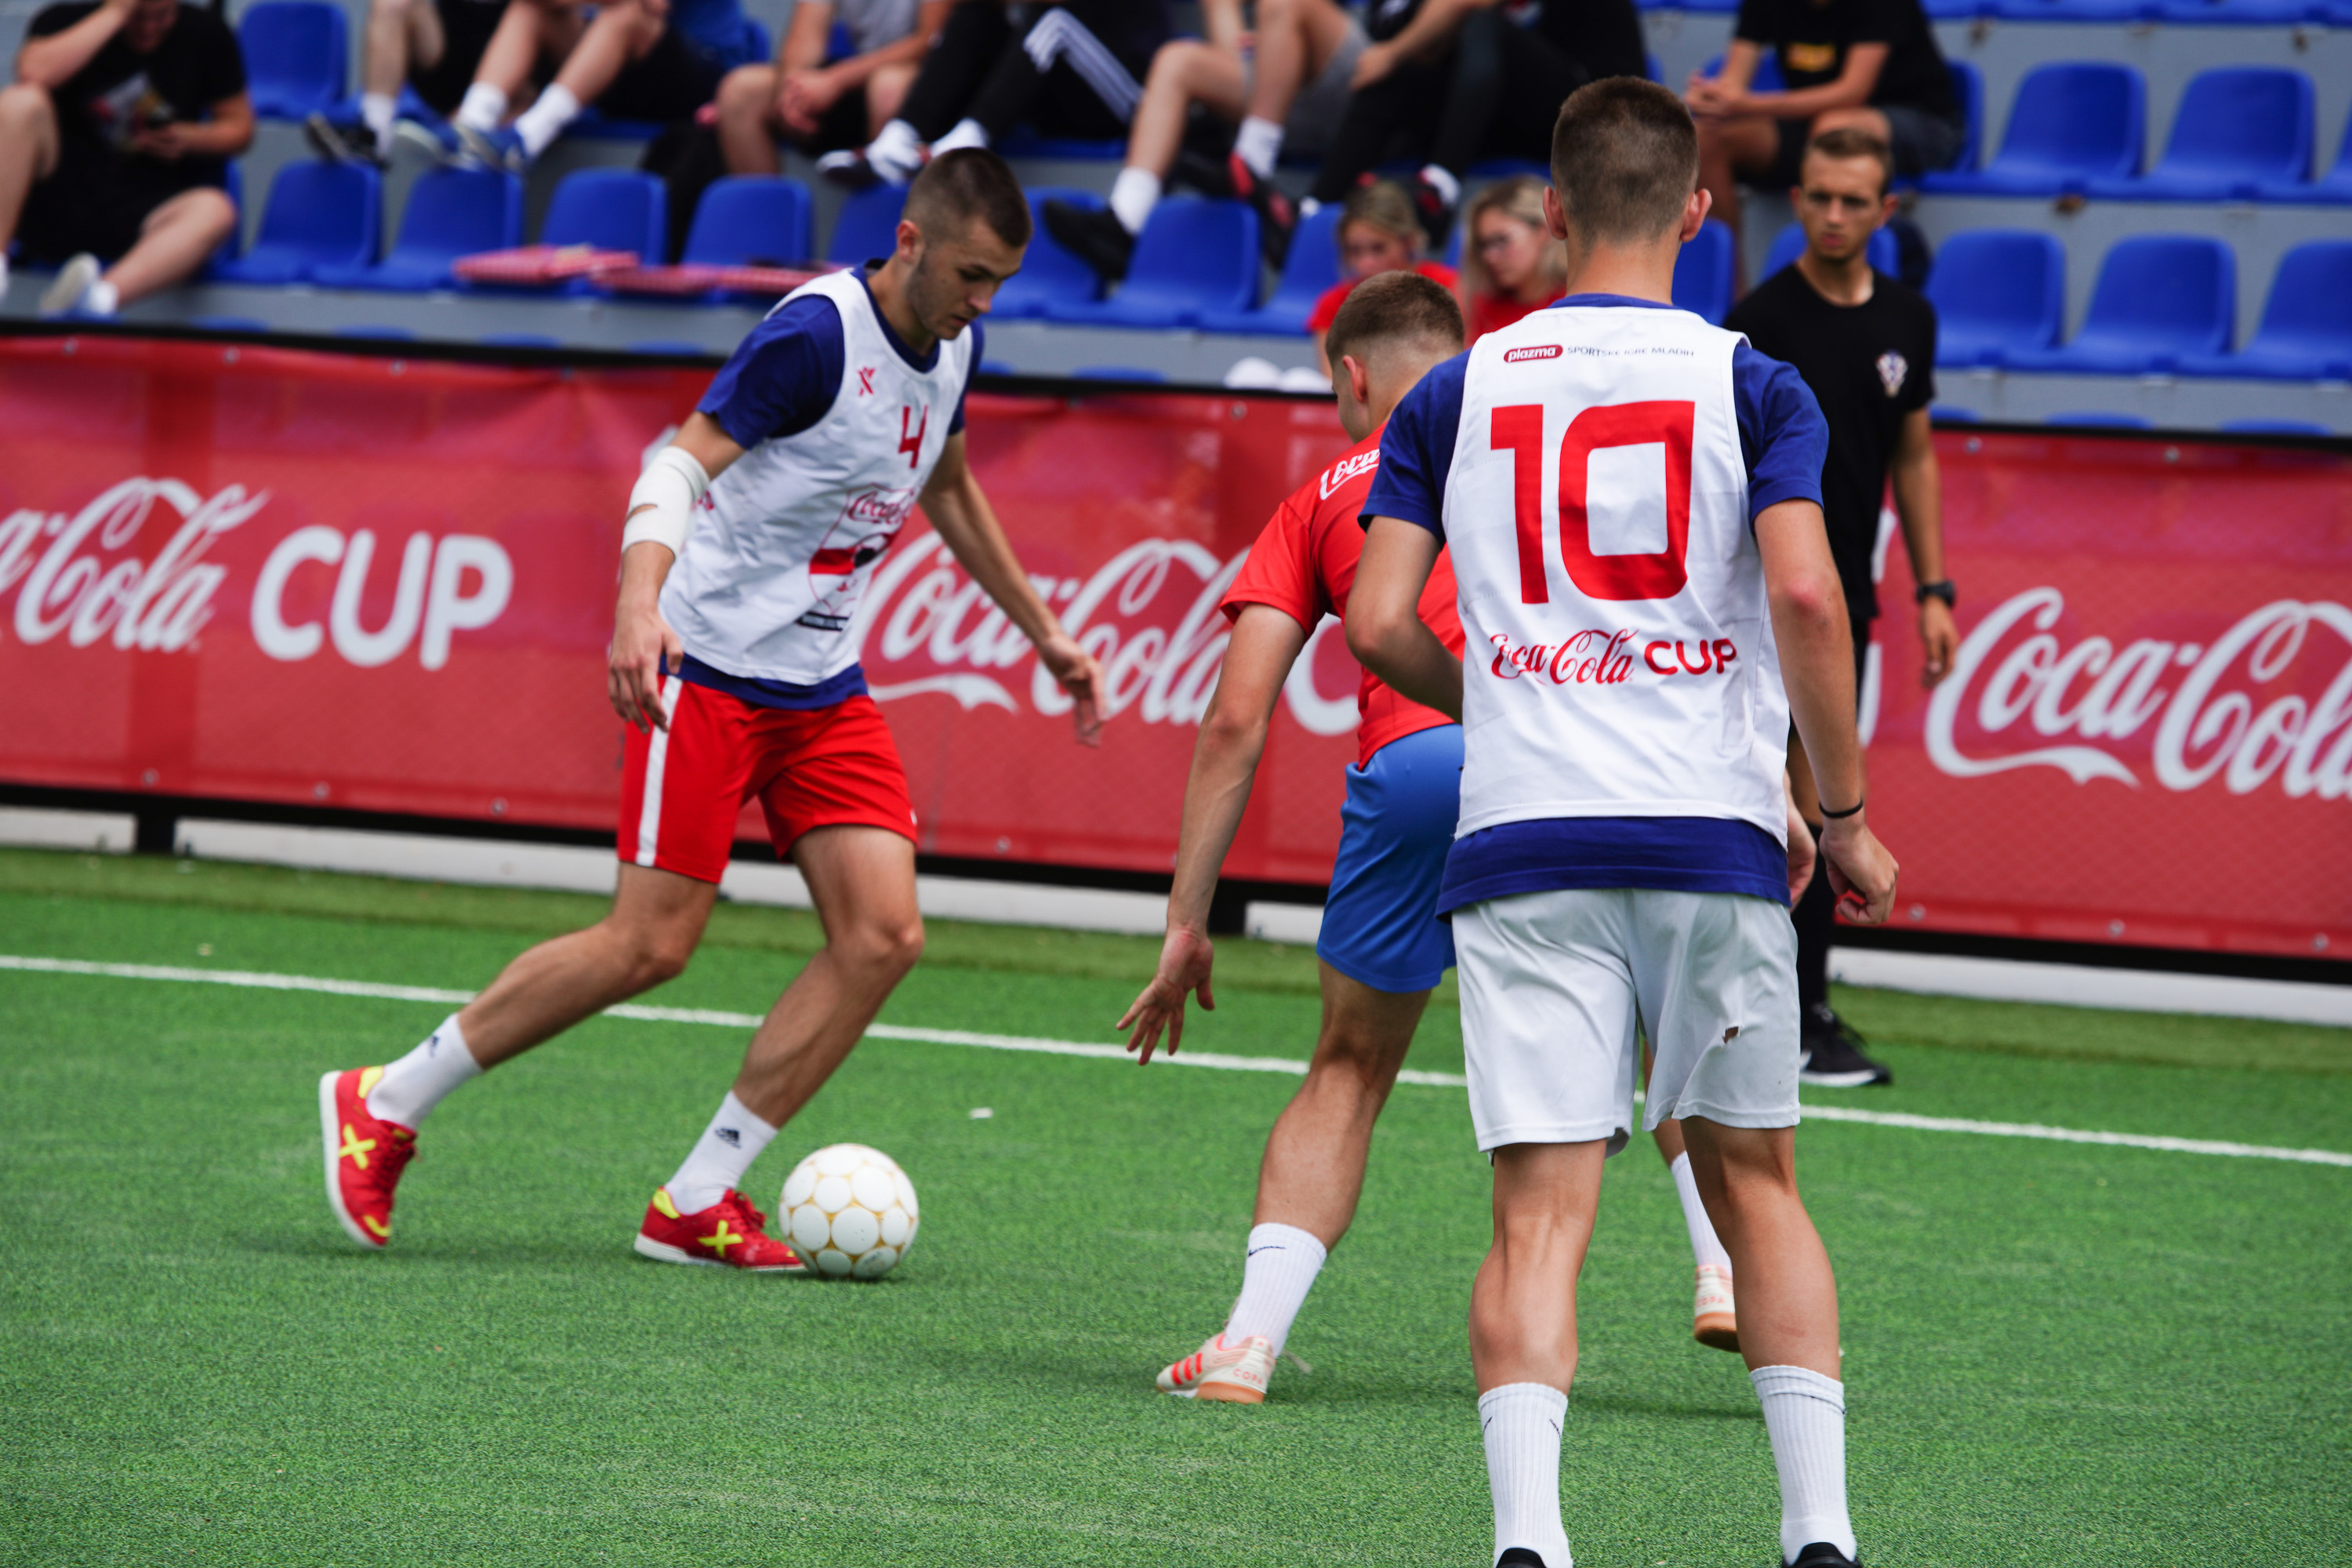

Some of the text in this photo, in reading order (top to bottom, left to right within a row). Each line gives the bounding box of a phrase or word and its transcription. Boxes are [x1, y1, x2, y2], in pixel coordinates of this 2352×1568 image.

[1508, 347, 1556, 362] plazma
[898, 405, 928, 469] 4
[1490, 400, 1695, 604] 10
[250, 525, 514, 671] CUP
[1644, 637, 1737, 676] CUP
[1232, 1367, 1264, 1386] COPA
